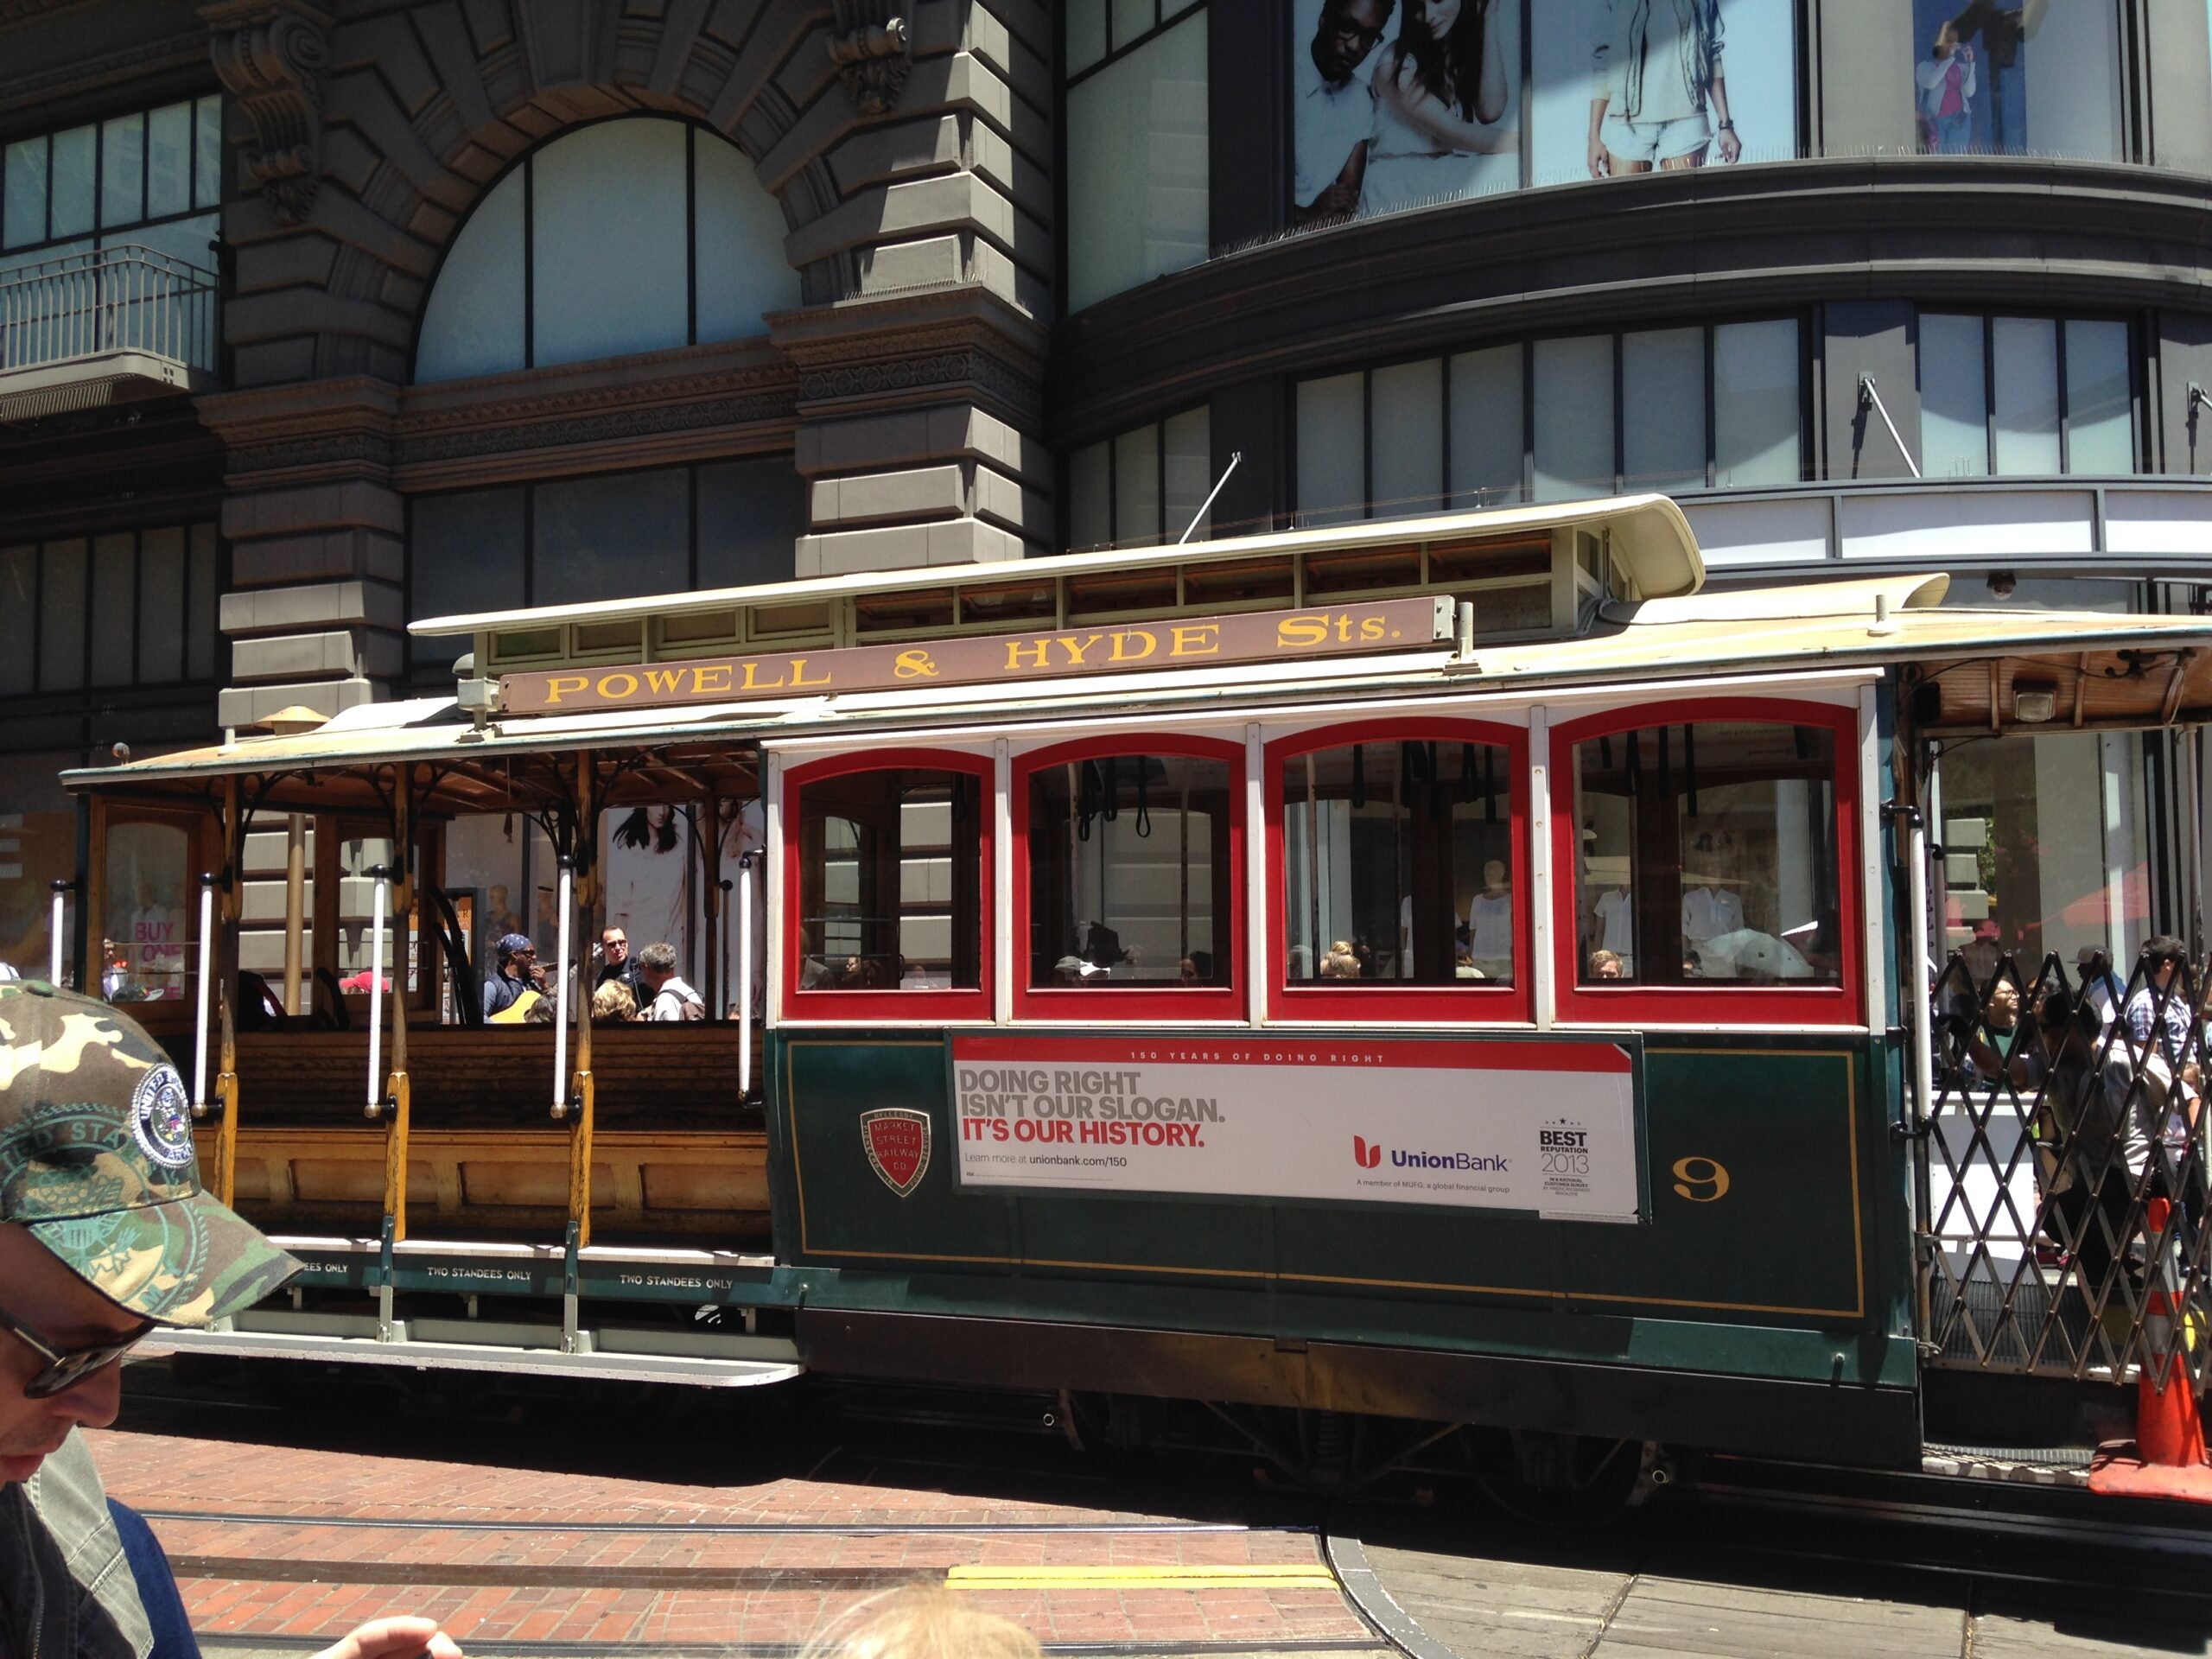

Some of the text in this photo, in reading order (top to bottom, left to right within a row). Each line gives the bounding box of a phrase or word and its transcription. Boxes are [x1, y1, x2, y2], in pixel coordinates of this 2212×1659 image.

[544, 613, 1402, 703] POWELL & HYDE Sts.
[135, 922, 175, 941] BUY
[143, 944, 181, 962] ONE
[1170, 1052, 1220, 1060] YEARS
[1233, 1052, 1251, 1061] OF
[1264, 1052, 1317, 1062] DOING
[1331, 1054, 1383, 1063] RIGHT
[959, 1069, 1141, 1095] DOING RIGHT
[960, 1094, 1225, 1122] ISN'T OUR SLOGAN.
[874, 1122, 916, 1133] MARKET
[963, 1118, 1205, 1147] IT'S OUR HISTORY.
[876, 1135, 917, 1146] STREET
[1540, 1130, 1586, 1147] BEST
[876, 1148, 920, 1160] RAILWAY
[965, 1153, 1128, 1167] Learn more at unionbank.com/150
[1391, 1150, 1509, 1172] UnionBank
[1541, 1154, 1590, 1174] 2013
[1433, 1183, 1454, 1192] global
[1673, 1157, 1730, 1202] 9
[325, 1263, 348, 1273] ONLY
[427, 1267, 531, 1281] TWO STANDEES ONLY
[620, 1274, 733, 1289] TWO STANDEES ONLY
